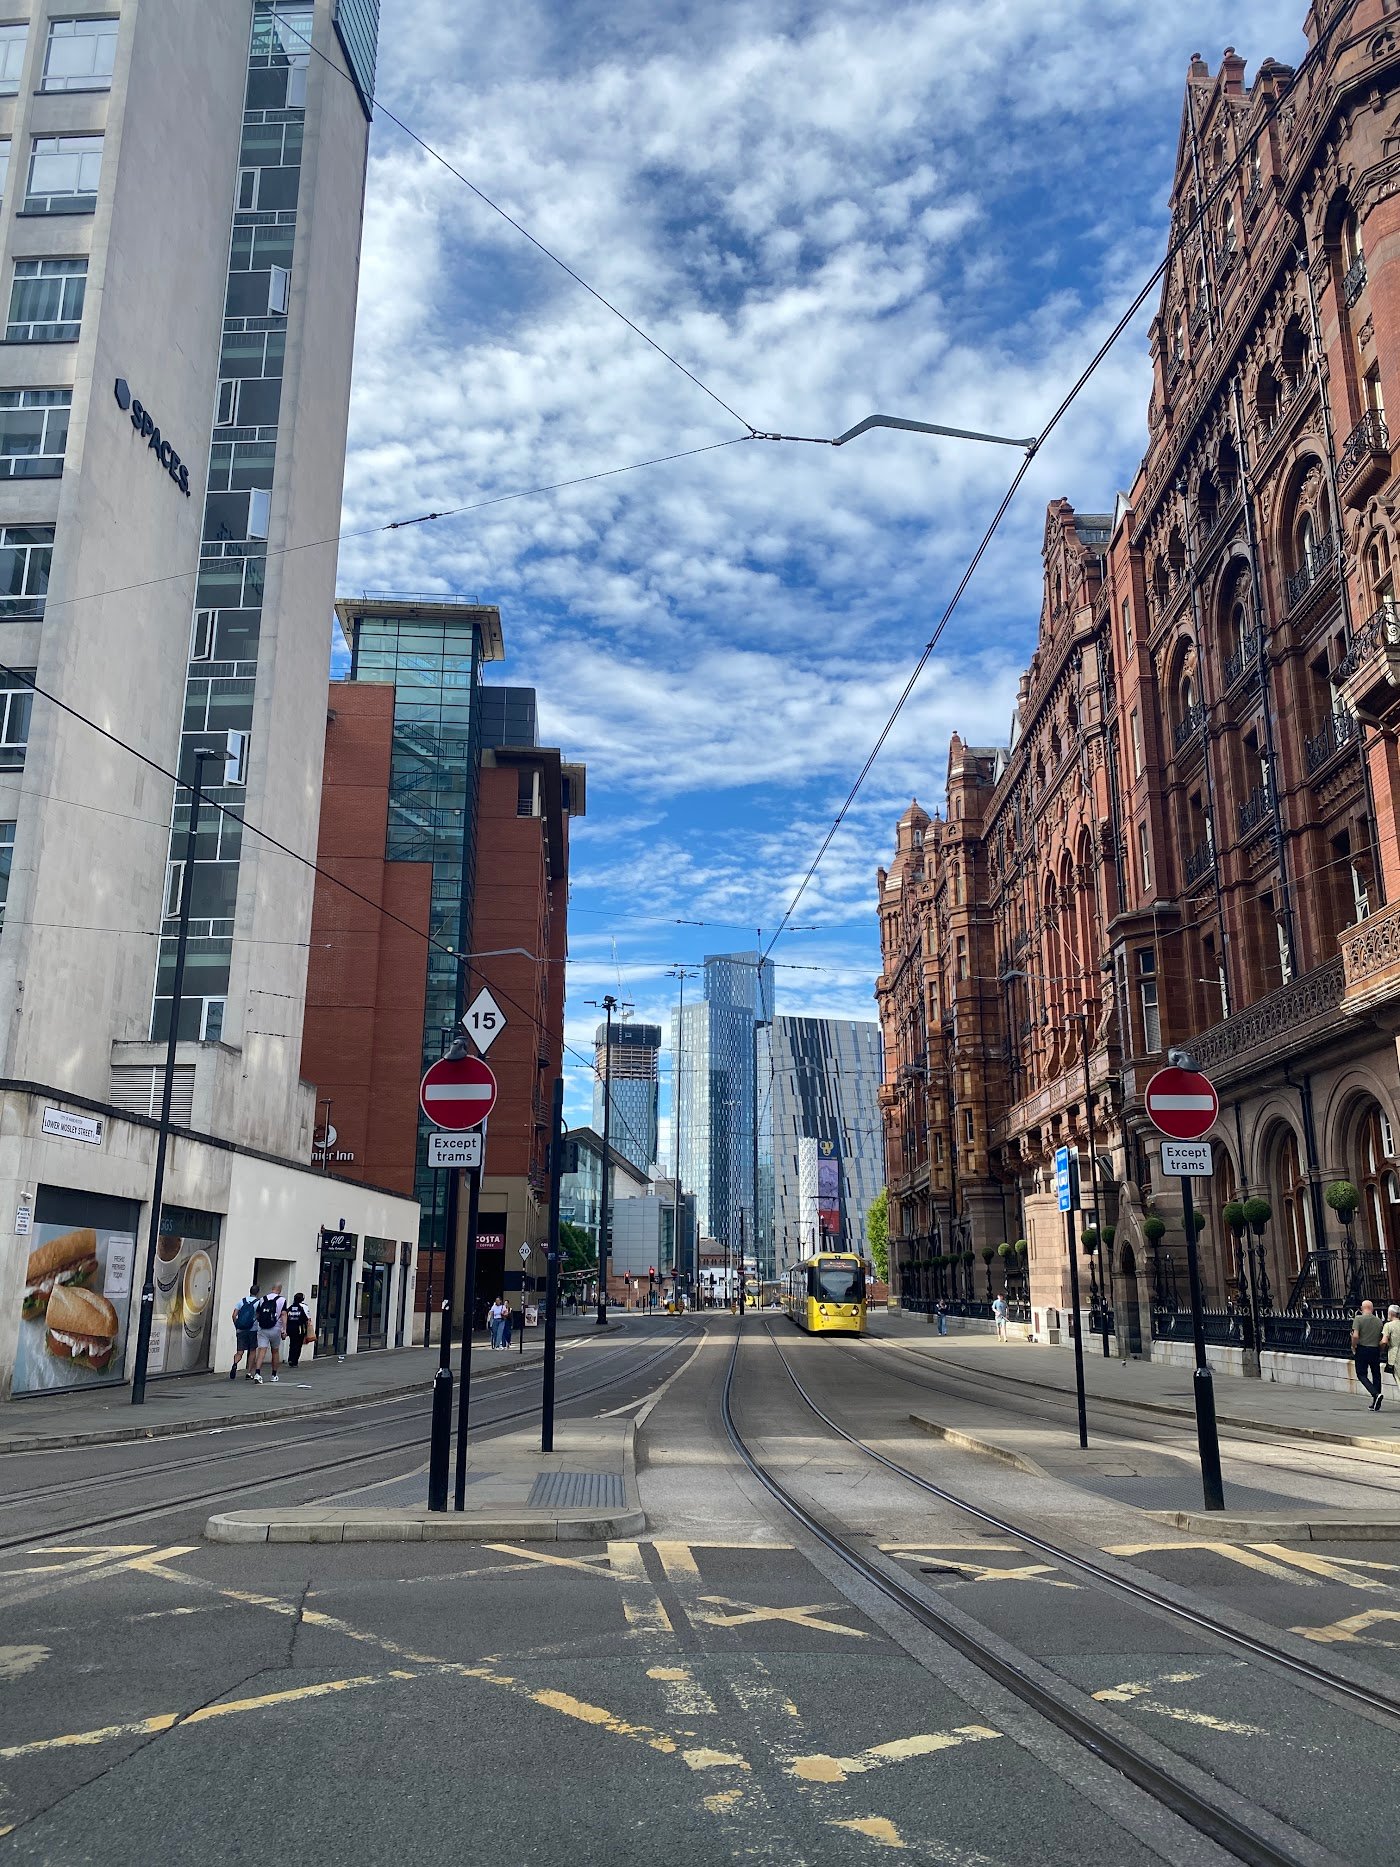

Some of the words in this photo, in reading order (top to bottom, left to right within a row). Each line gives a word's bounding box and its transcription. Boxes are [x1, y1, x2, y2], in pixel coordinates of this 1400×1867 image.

[472, 1012, 496, 1029] 15
[45, 1120, 60, 1130] LOWER
[61, 1123, 77, 1134] MOSLEY
[77, 1128, 93, 1138] STREET
[434, 1138, 477, 1150] Except
[336, 1150, 354, 1160] Inn
[437, 1152, 472, 1162] trams
[1167, 1147, 1207, 1158] Except
[1171, 1160, 1205, 1170] trams
